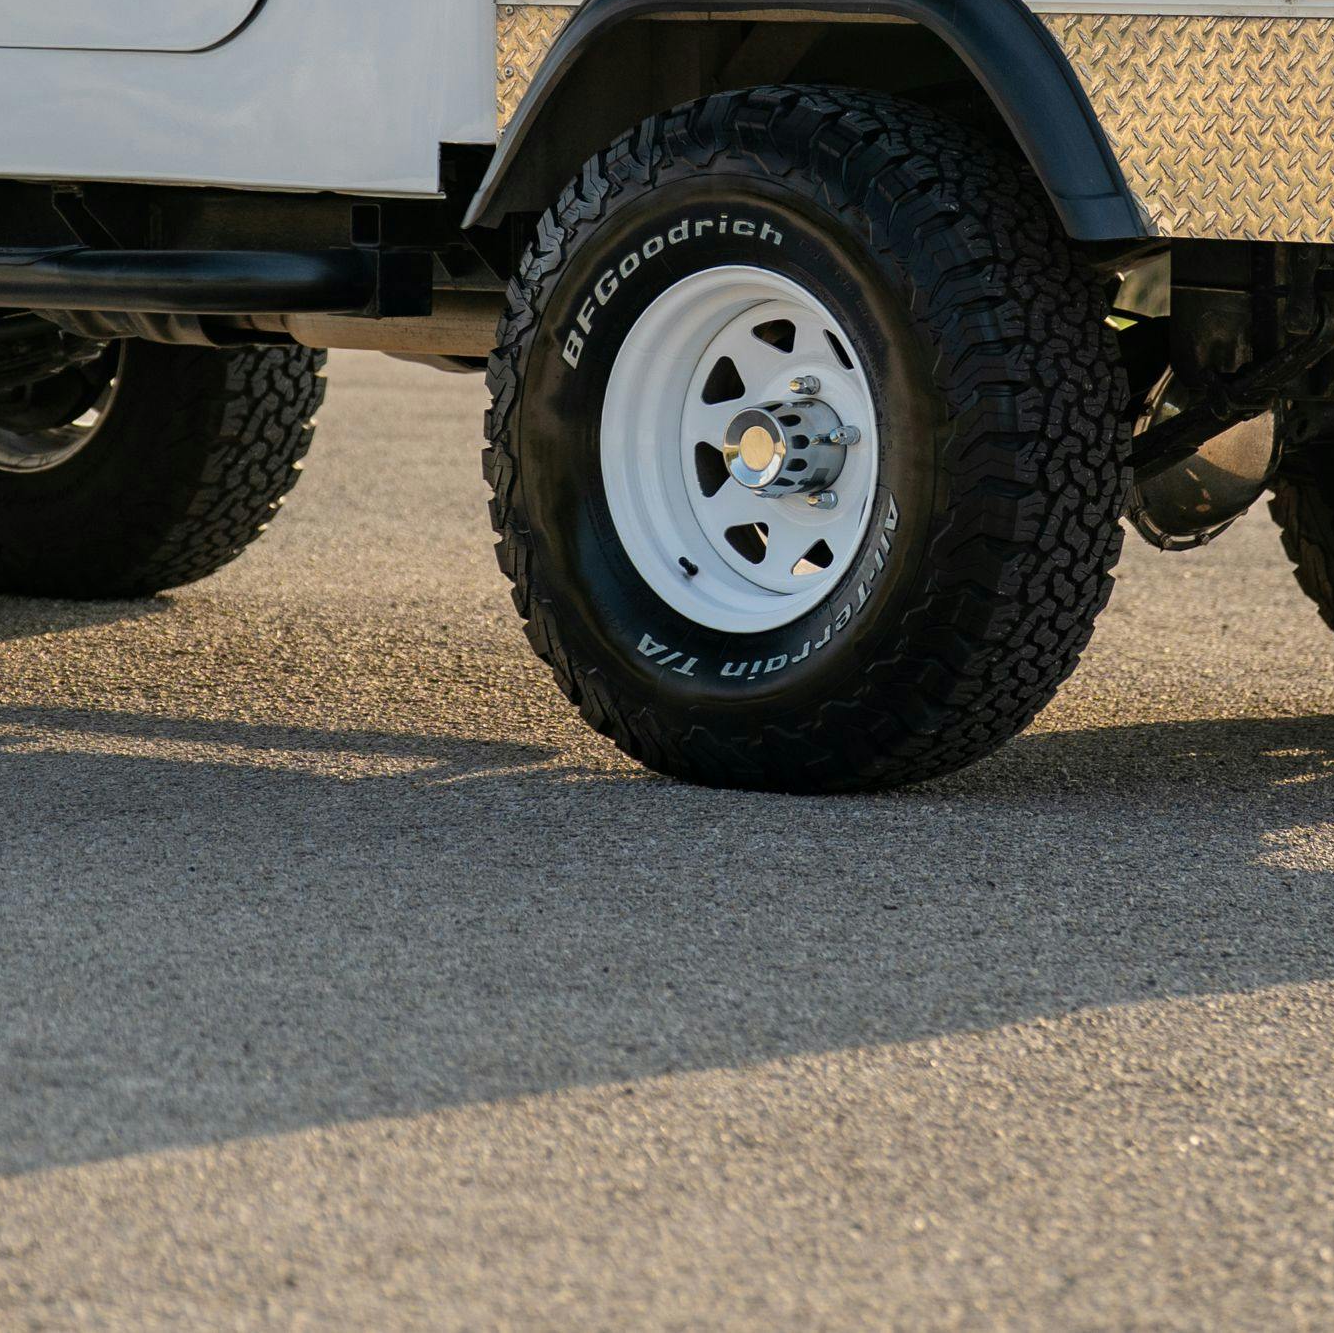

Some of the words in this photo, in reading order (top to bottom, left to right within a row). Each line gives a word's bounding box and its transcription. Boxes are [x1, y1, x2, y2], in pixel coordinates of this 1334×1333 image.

[561, 212, 785, 371] BFGoodrich
[636, 632, 700, 677] T/A
[719, 492, 898, 680] All-Terrain
